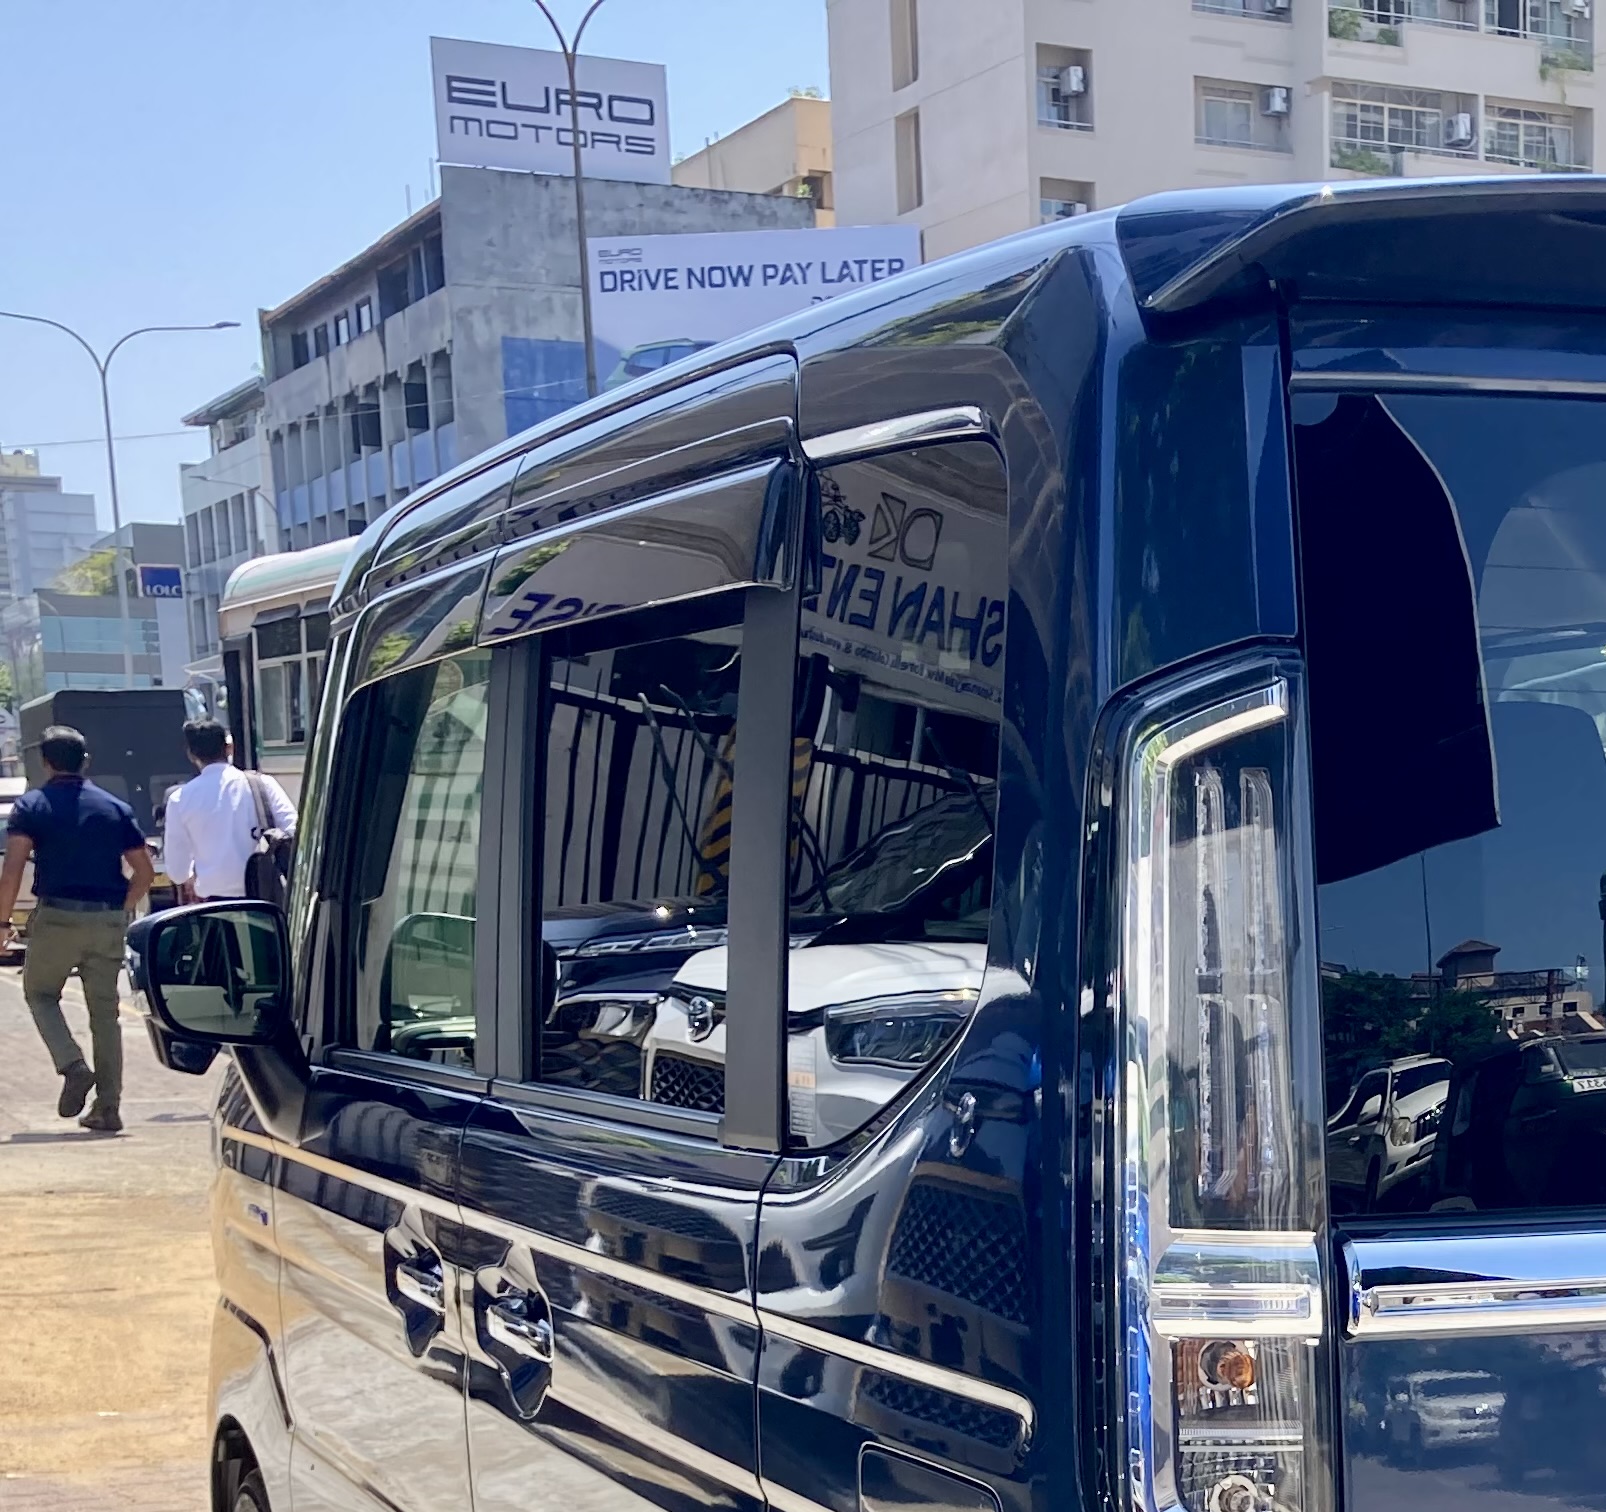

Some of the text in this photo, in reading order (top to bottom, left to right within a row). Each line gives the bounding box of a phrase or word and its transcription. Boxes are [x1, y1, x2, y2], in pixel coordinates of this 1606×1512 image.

[446, 75, 654, 126] EURO
[450, 115, 655, 155] MOTORS
[687, 264, 754, 290] NOW
[762, 262, 813, 286] PAY
[821, 258, 905, 284] LATER
